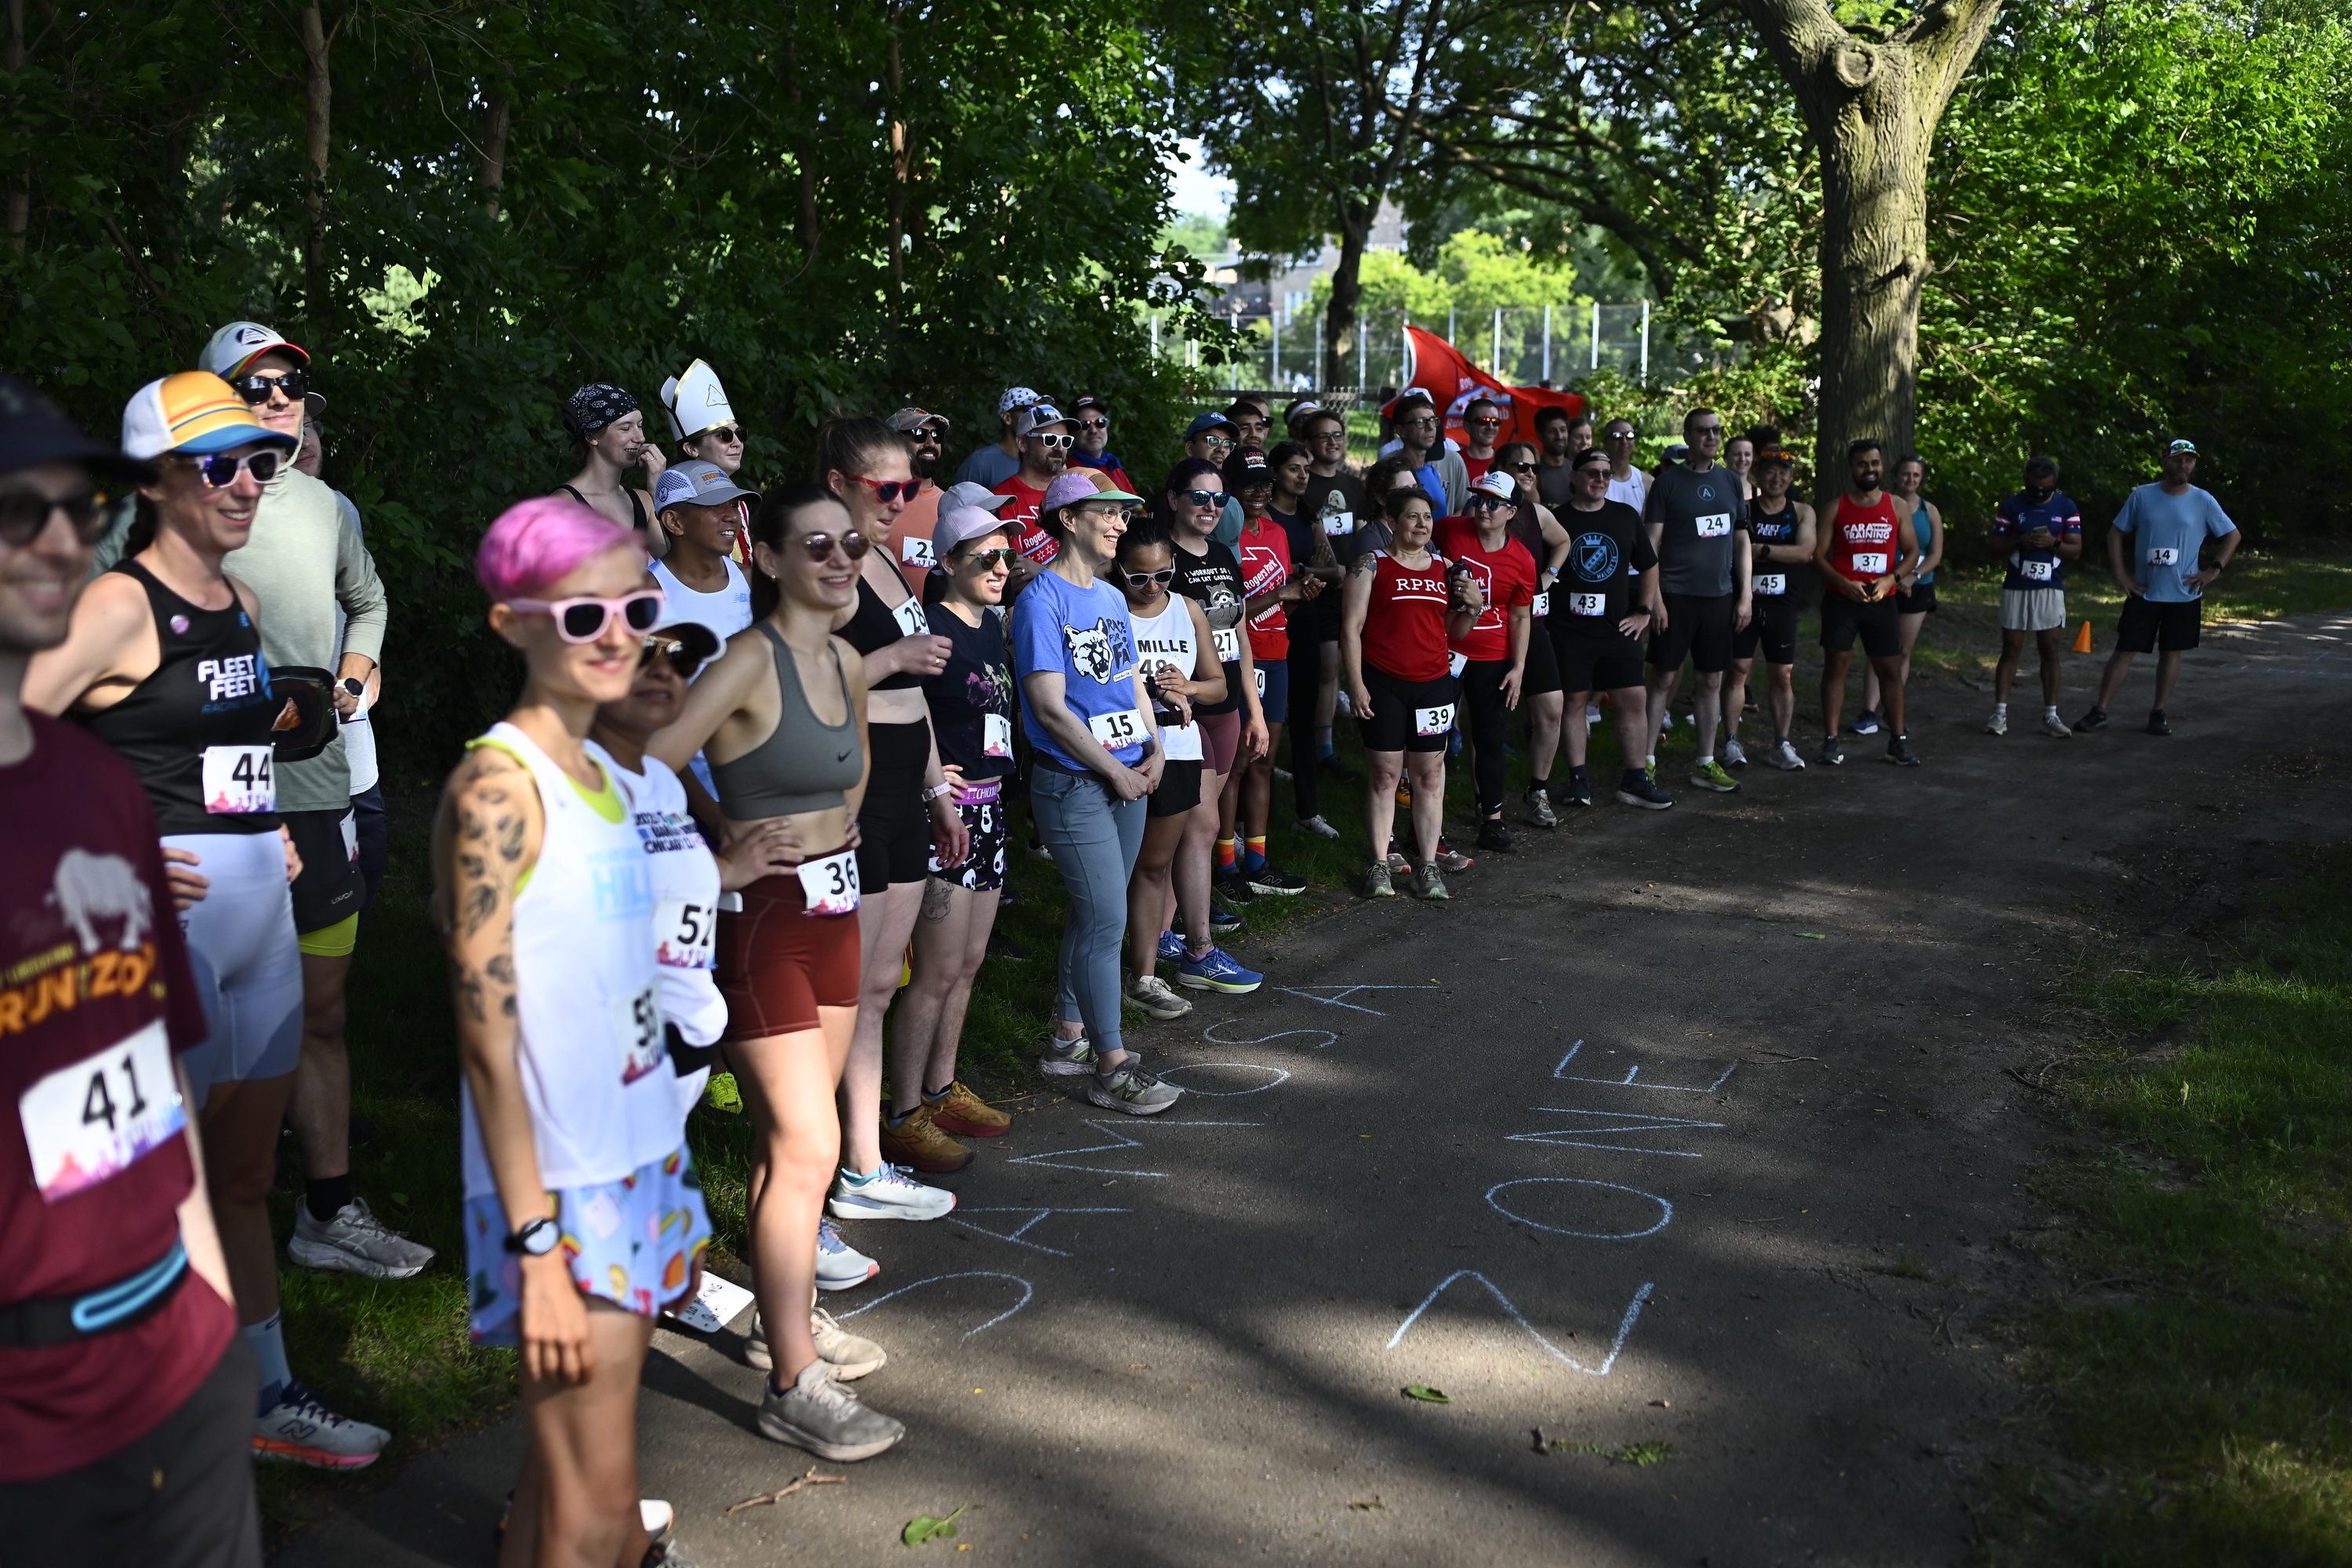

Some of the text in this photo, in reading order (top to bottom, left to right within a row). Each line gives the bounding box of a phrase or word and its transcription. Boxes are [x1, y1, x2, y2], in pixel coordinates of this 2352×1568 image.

[1334, 516, 1343, 528] 3
[1705, 517, 1723, 530] 24
[1757, 522, 1780, 532] FLEET
[1843, 523, 1874, 534] CARA
[1846, 530, 1890, 540] TRAINING
[1862, 555, 1879, 567] 37
[2154, 550, 2170, 560] 14
[1189, 568, 1218, 576] WORKOUT
[1243, 559, 1278, 590] Rogers Park
[2029, 563, 2045, 575] 53
[1396, 579, 1446, 594] RPRC
[1760, 577, 1778, 589] 45
[1541, 595, 1548, 609] 3
[1577, 595, 1596, 609] 43
[905, 601, 927, 633] 28
[1109, 633, 1120, 644] FOR
[1214, 632, 1231, 652] 27
[197, 654, 255, 683] FLEET
[1139, 659, 1167, 678] 48
[209, 674, 256, 701] FEET
[1428, 709, 1449, 727] 39
[1106, 714, 1134, 739] 15
[232, 753, 270, 791] 44
[825, 858, 857, 895] 36
[82, 1052, 147, 1131] 41
[1386, 1039, 1739, 1376] ZONE
